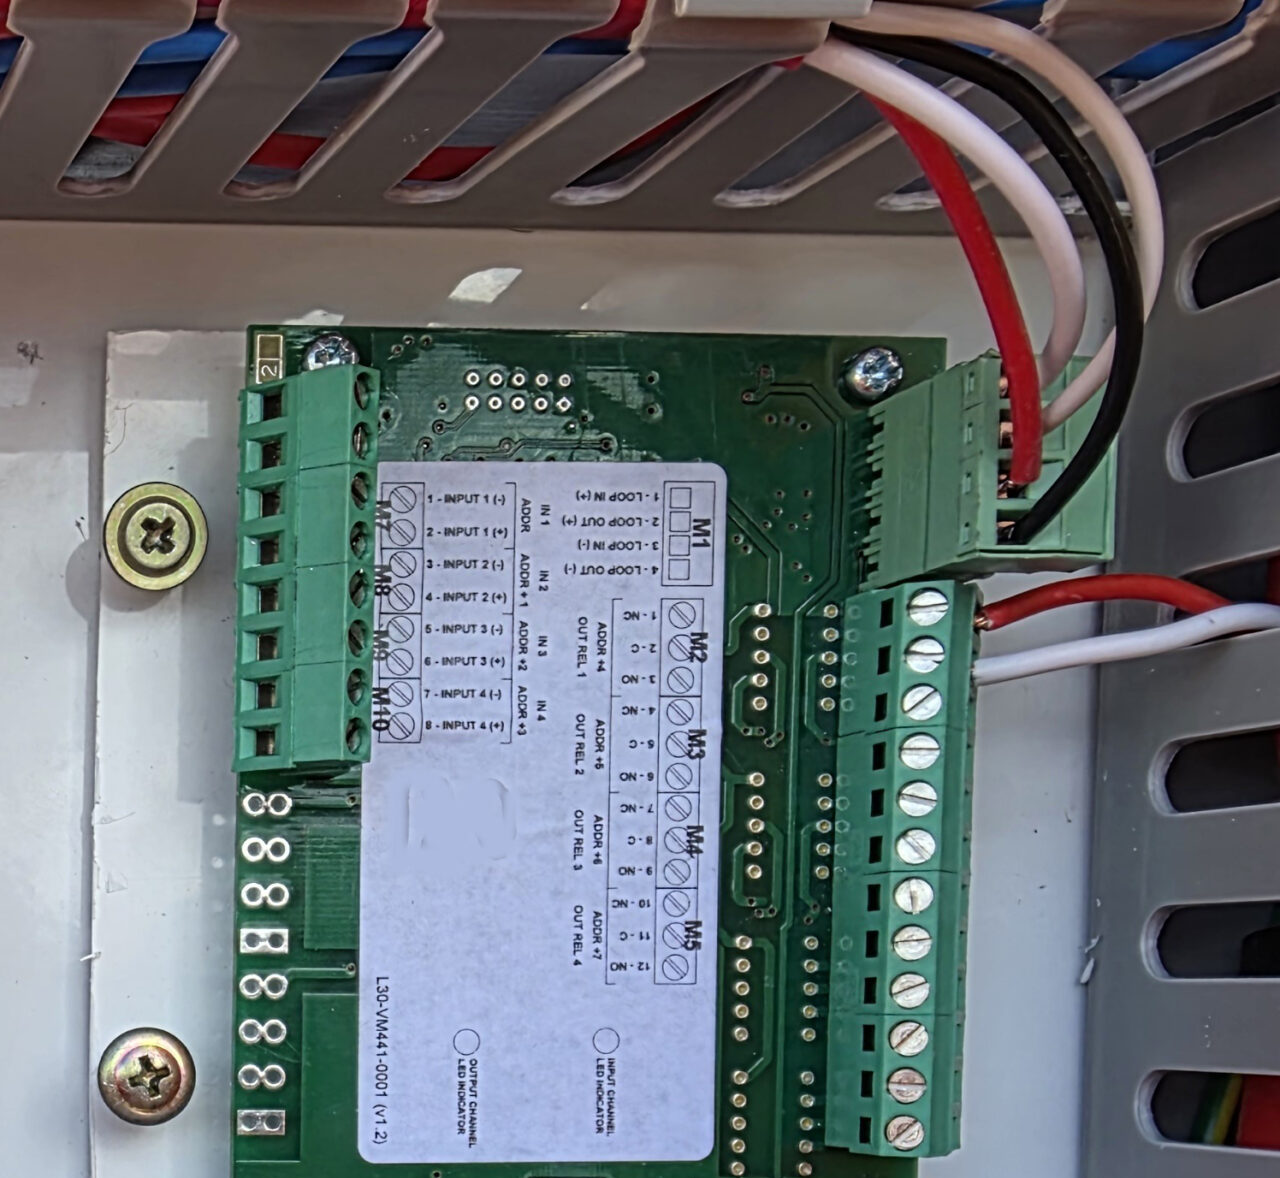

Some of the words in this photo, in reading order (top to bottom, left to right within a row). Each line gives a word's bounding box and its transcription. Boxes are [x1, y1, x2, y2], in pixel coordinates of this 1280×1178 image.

[261, 365, 277, 377] 2
[520, 497, 532, 533] ADDR
[692, 518, 712, 548] M1
[374, 564, 392, 596] M8
[519, 553, 531, 589] ADDR
[518, 620, 529, 655] ADDR
[577, 616, 589, 642] OUT
[596, 621, 608, 656] ADDR
[576, 644, 588, 669] REL
[690, 632, 709, 663] M2
[517, 658, 528, 672] +2
[596, 659, 606, 673] +4
[372, 686, 391, 731] M10
[517, 685, 528, 720] ADDR
[442, 720, 476, 731] INPUT
[488, 720, 505, 733] (+)
[516, 722, 528, 736] +3
[575, 713, 586, 740] OUT
[594, 718, 606, 753] ADDR
[574, 741, 586, 766] REL
[688, 729, 707, 759] M3
[573, 809, 585, 835] OUT
[592, 814, 604, 849] ADDR
[572, 837, 584, 861] REL
[686, 825, 704, 858] M4
[592, 851, 603, 865] +6
[573, 904, 584, 930] OUT
[592, 910, 603, 945] ADDR
[572, 932, 584, 957] REL
[684, 920, 702, 951] M5
[592, 947, 603, 961] +7
[375, 976, 389, 1100] L30-VM441-0001
[457, 1058, 467, 1079] LED
[468, 1058, 478, 1097] OUTPUT
[595, 1057, 605, 1078] LED
[606, 1057, 616, 1087] INPUT
[457, 1080, 467, 1135] INDICATOR
[595, 1079, 605, 1134] INDICATOR
[606, 1089, 616, 1137] CHANNEL
[373, 1104, 388, 1144] (v1.2)
[468, 1100, 478, 1149] CHANNEL
